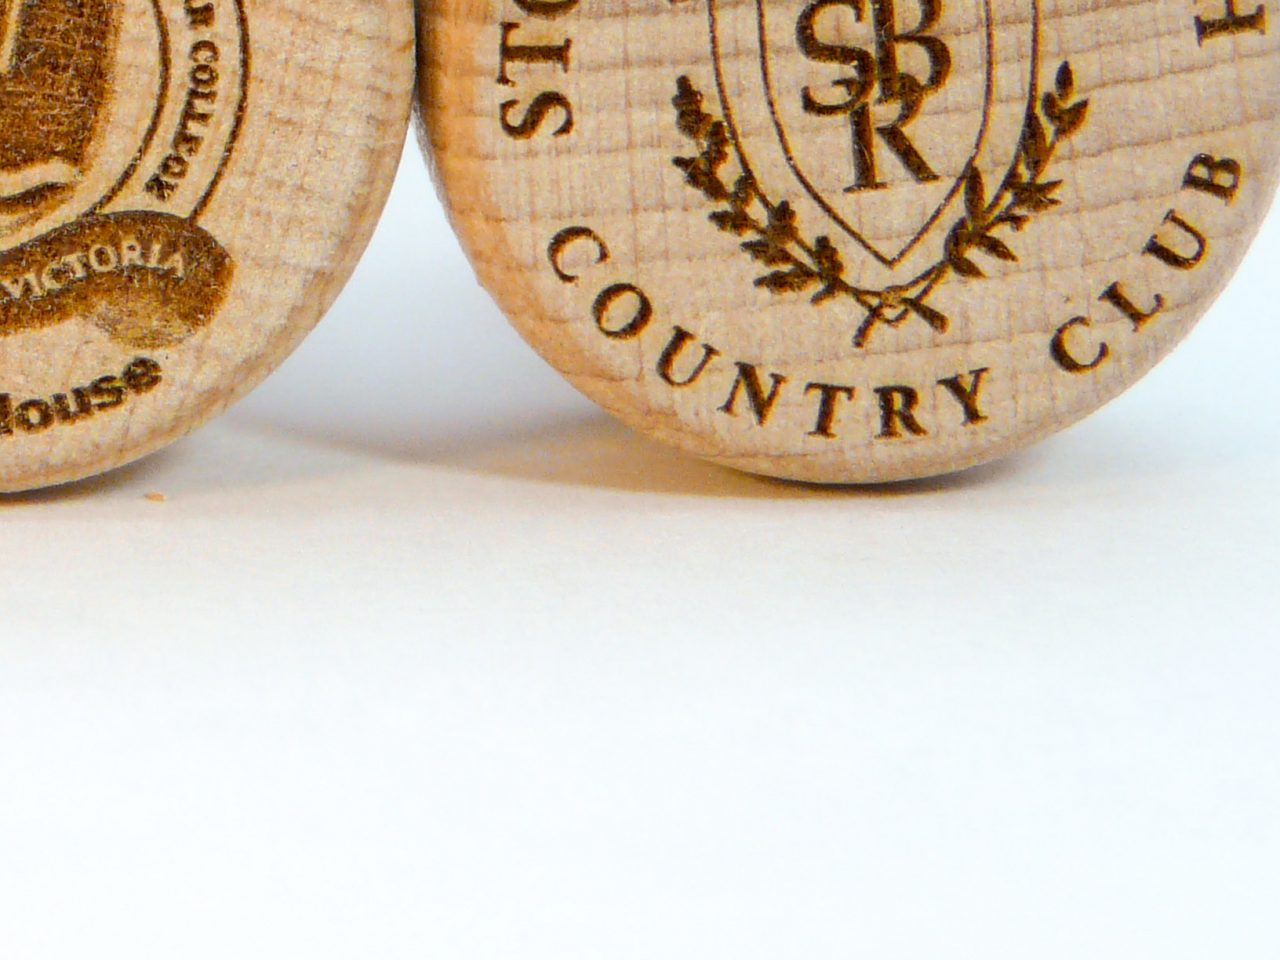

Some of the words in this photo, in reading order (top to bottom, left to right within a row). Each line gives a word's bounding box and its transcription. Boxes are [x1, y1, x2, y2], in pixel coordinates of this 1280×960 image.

[144, 40, 219, 202] COLLEGE
[2, 237, 187, 302] VICTORIA
[546, 225, 990, 439] COUNTRY
[1049, 152, 1243, 373] CLUB
